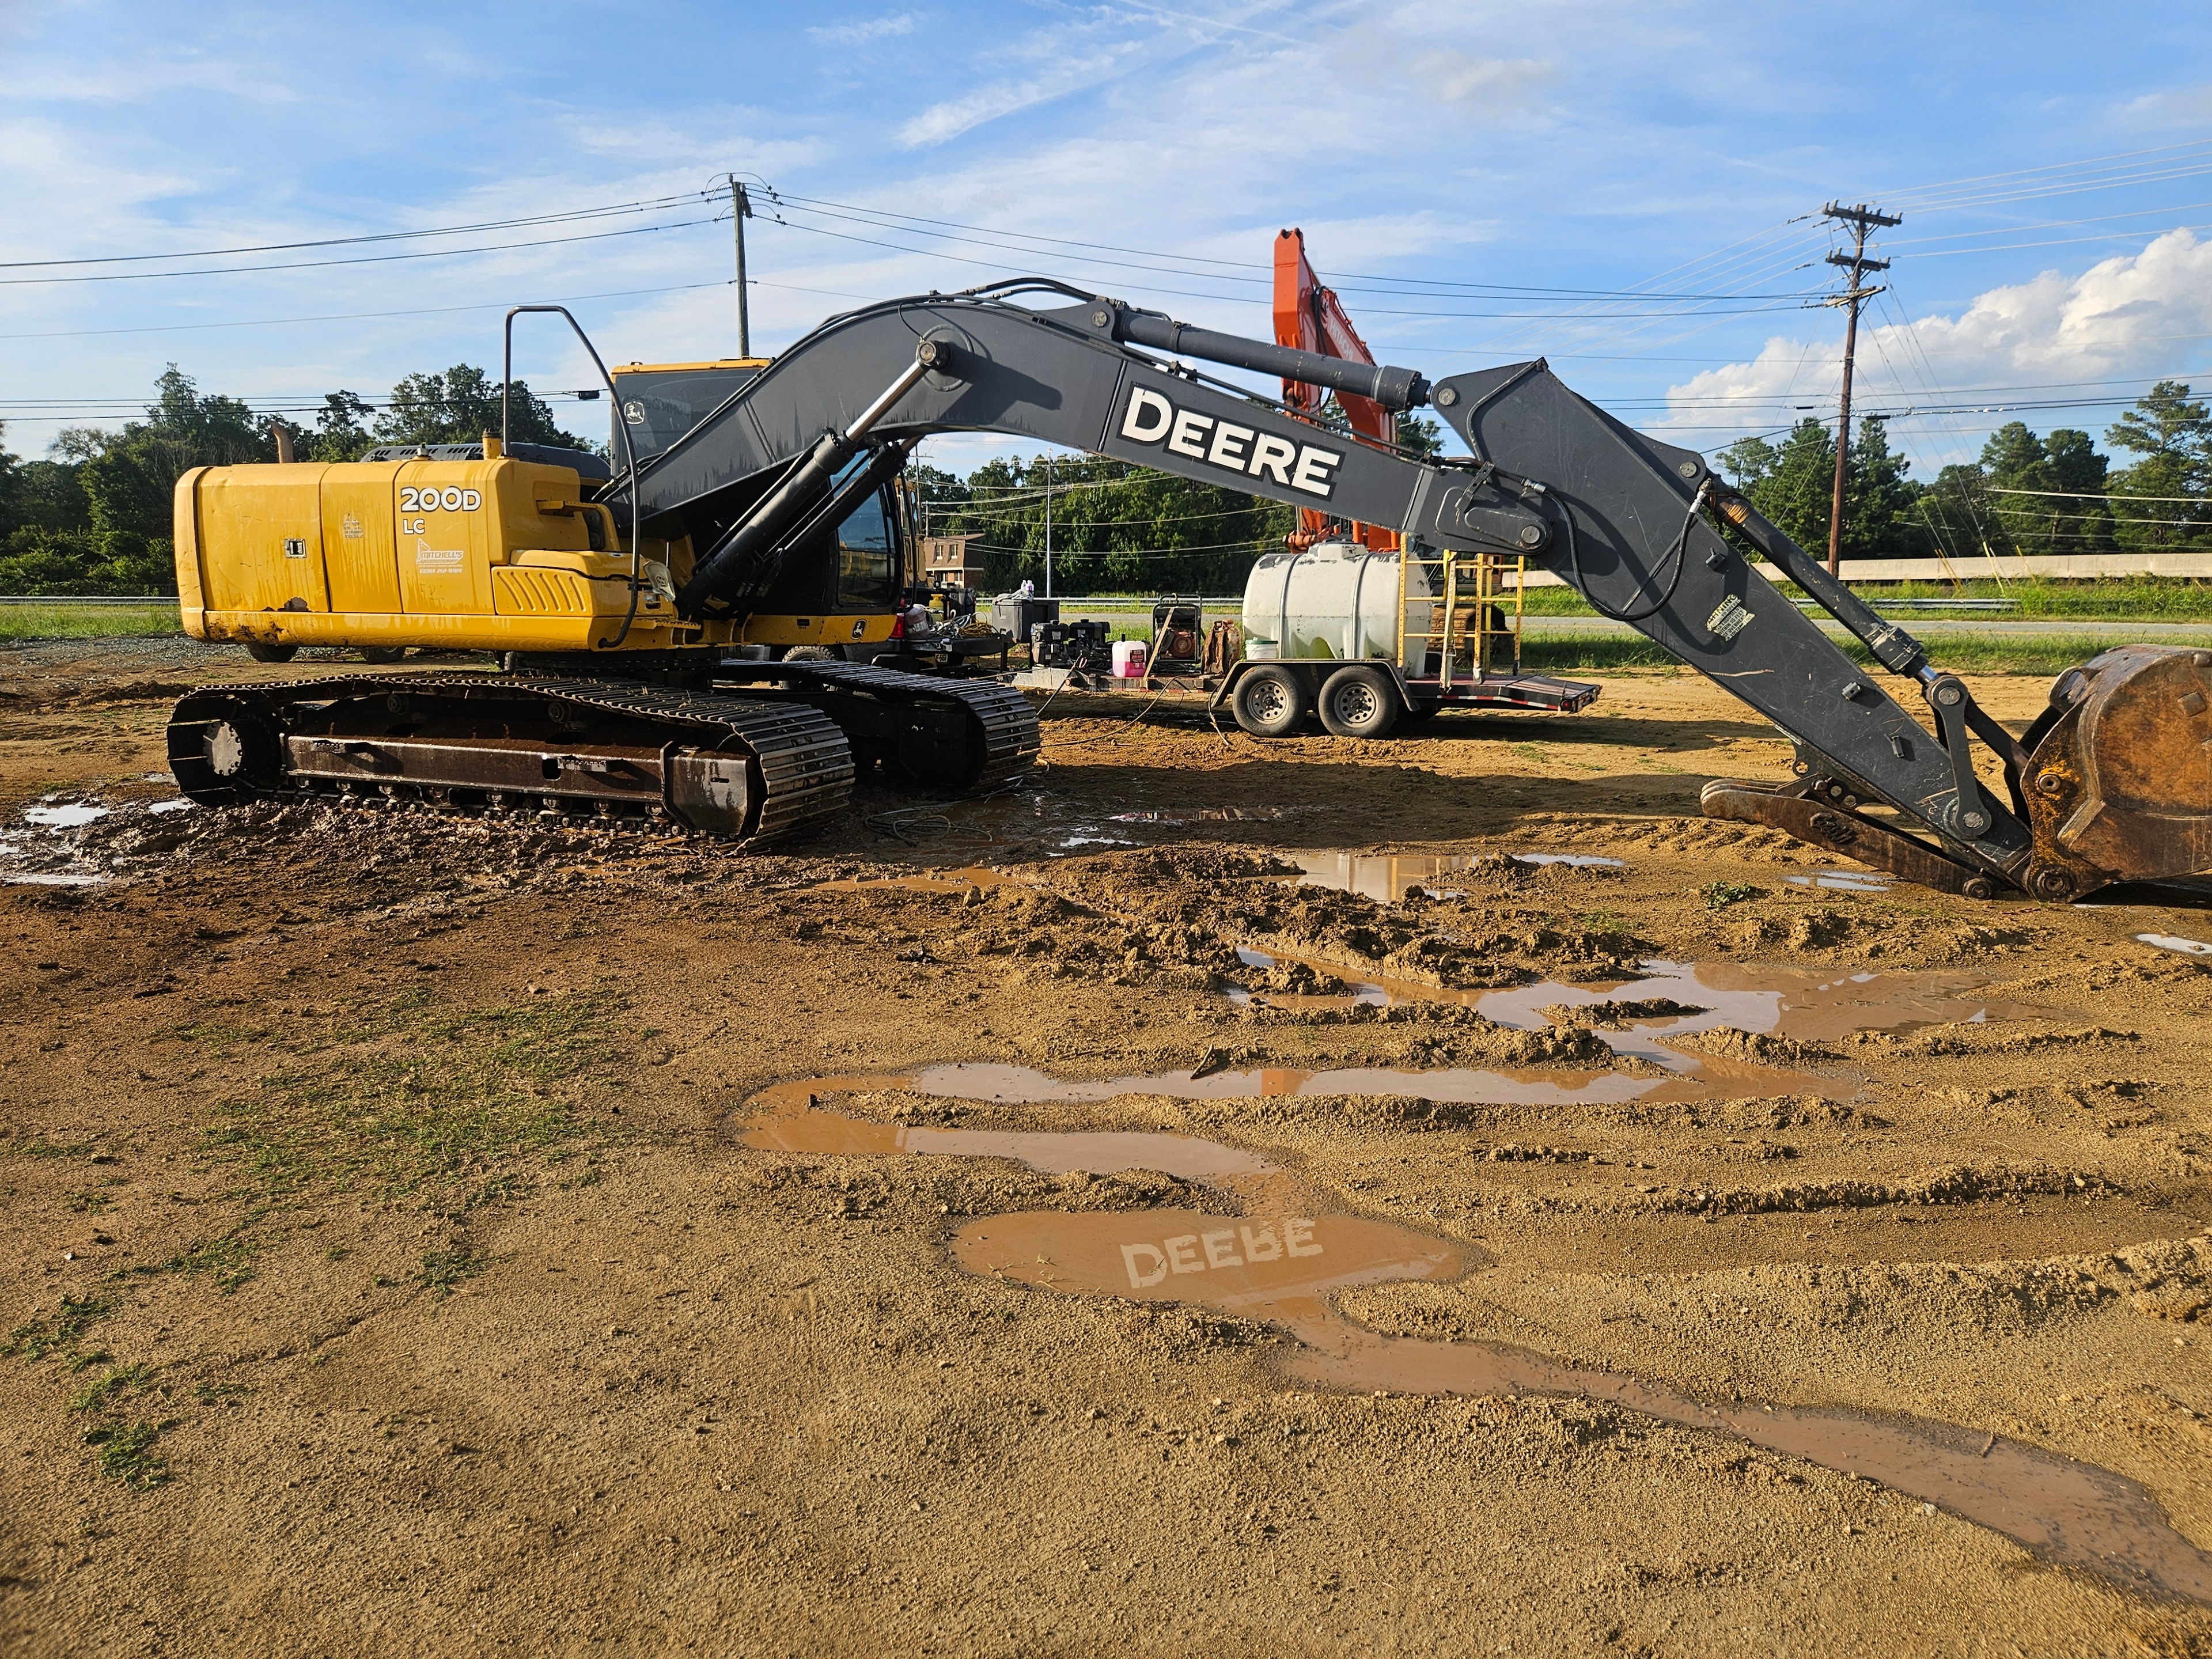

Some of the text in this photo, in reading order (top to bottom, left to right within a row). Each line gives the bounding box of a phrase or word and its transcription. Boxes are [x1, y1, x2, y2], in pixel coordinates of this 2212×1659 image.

[1330, 320, 1353, 361] HITACHI
[1121, 386, 1340, 497] DEERE
[401, 486, 482, 512] 200D
[403, 518, 425, 535] LC
[1734, 610, 1744, 619] FEET
